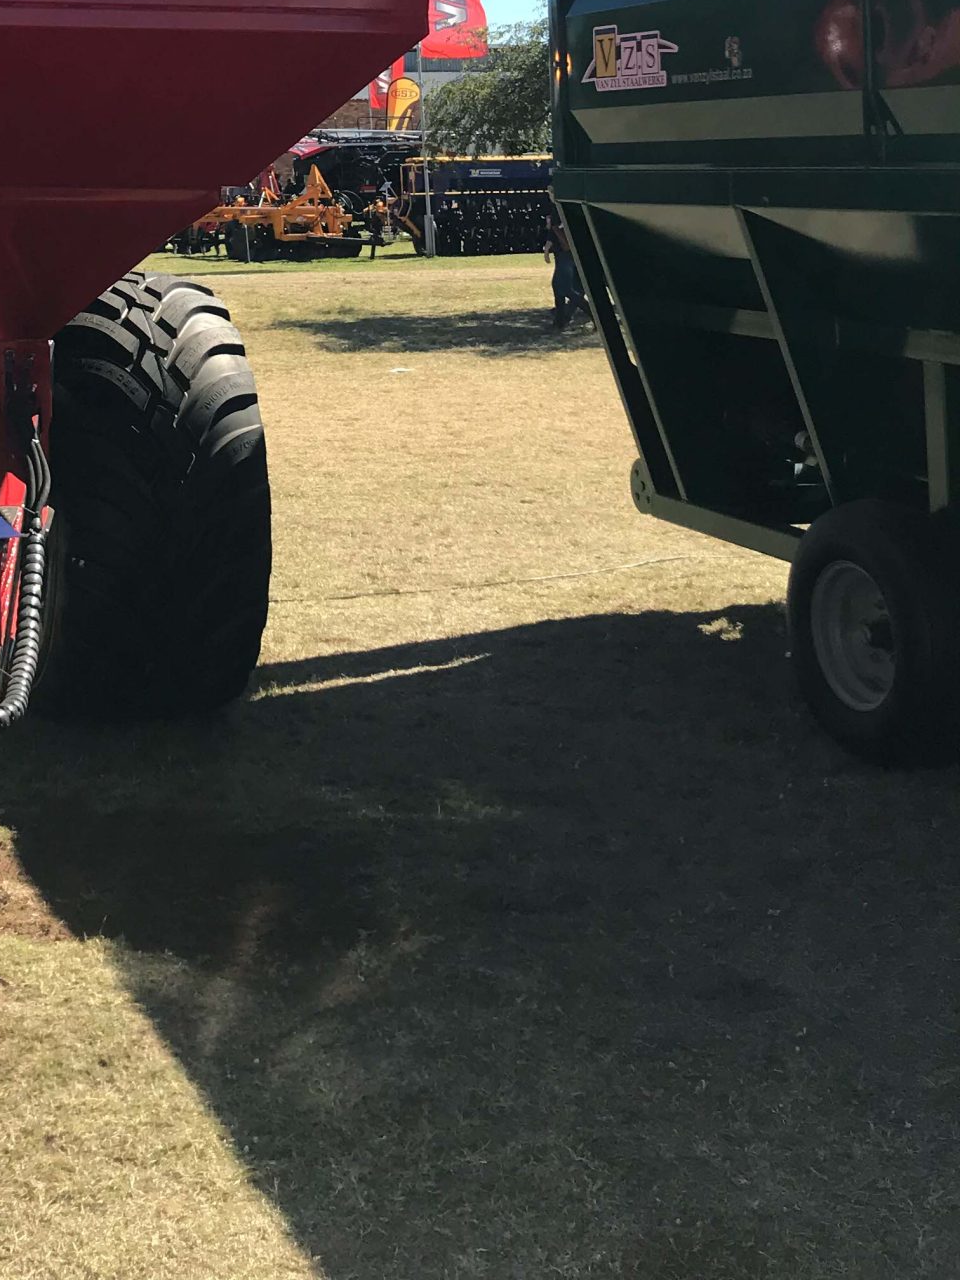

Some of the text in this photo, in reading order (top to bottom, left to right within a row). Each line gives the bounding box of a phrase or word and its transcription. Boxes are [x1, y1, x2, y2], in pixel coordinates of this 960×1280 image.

[596, 37, 656, 73] V.Z.S
[610, 78, 622, 89] ZYL
[622, 74, 666, 88] STAALWERKE
